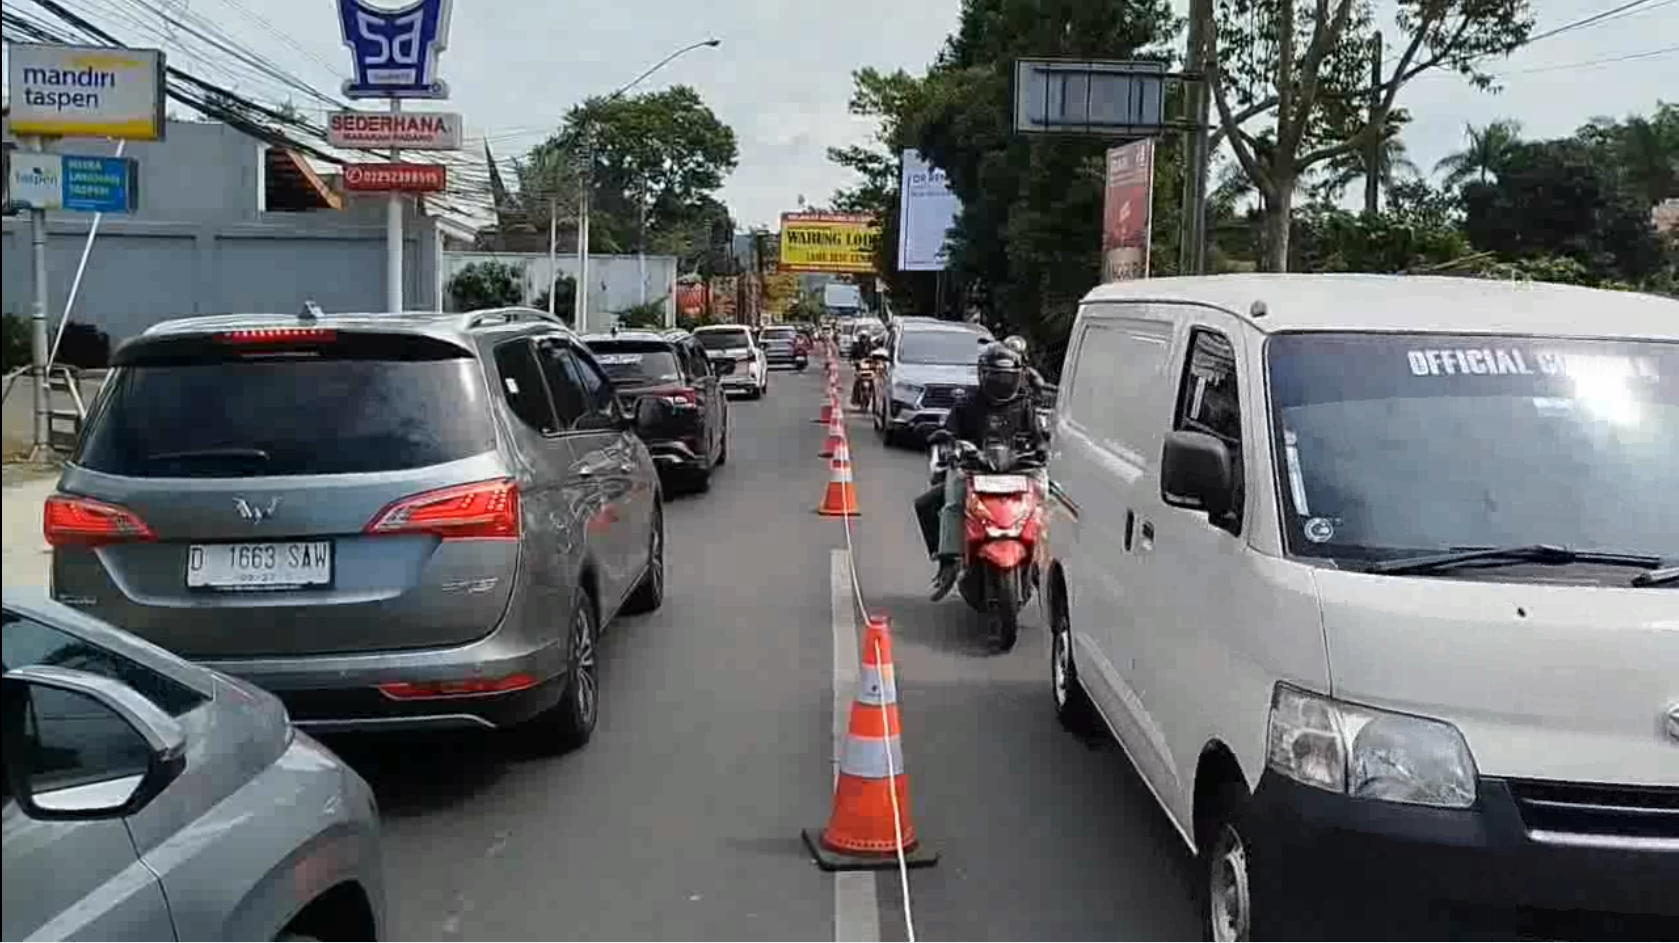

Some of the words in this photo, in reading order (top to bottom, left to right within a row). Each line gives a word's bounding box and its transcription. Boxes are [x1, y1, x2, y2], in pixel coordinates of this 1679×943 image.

[23, 66, 115, 88] mandiri
[24, 88, 99, 111] taspen
[331, 115, 447, 133] SEDERHANA
[787, 231, 841, 245] WARUNG
[1407, 349, 1534, 376] OFFICIAL
[190, 547, 204, 571] D
[230, 545, 276, 569] 1663
[288, 543, 327, 568] SAW
